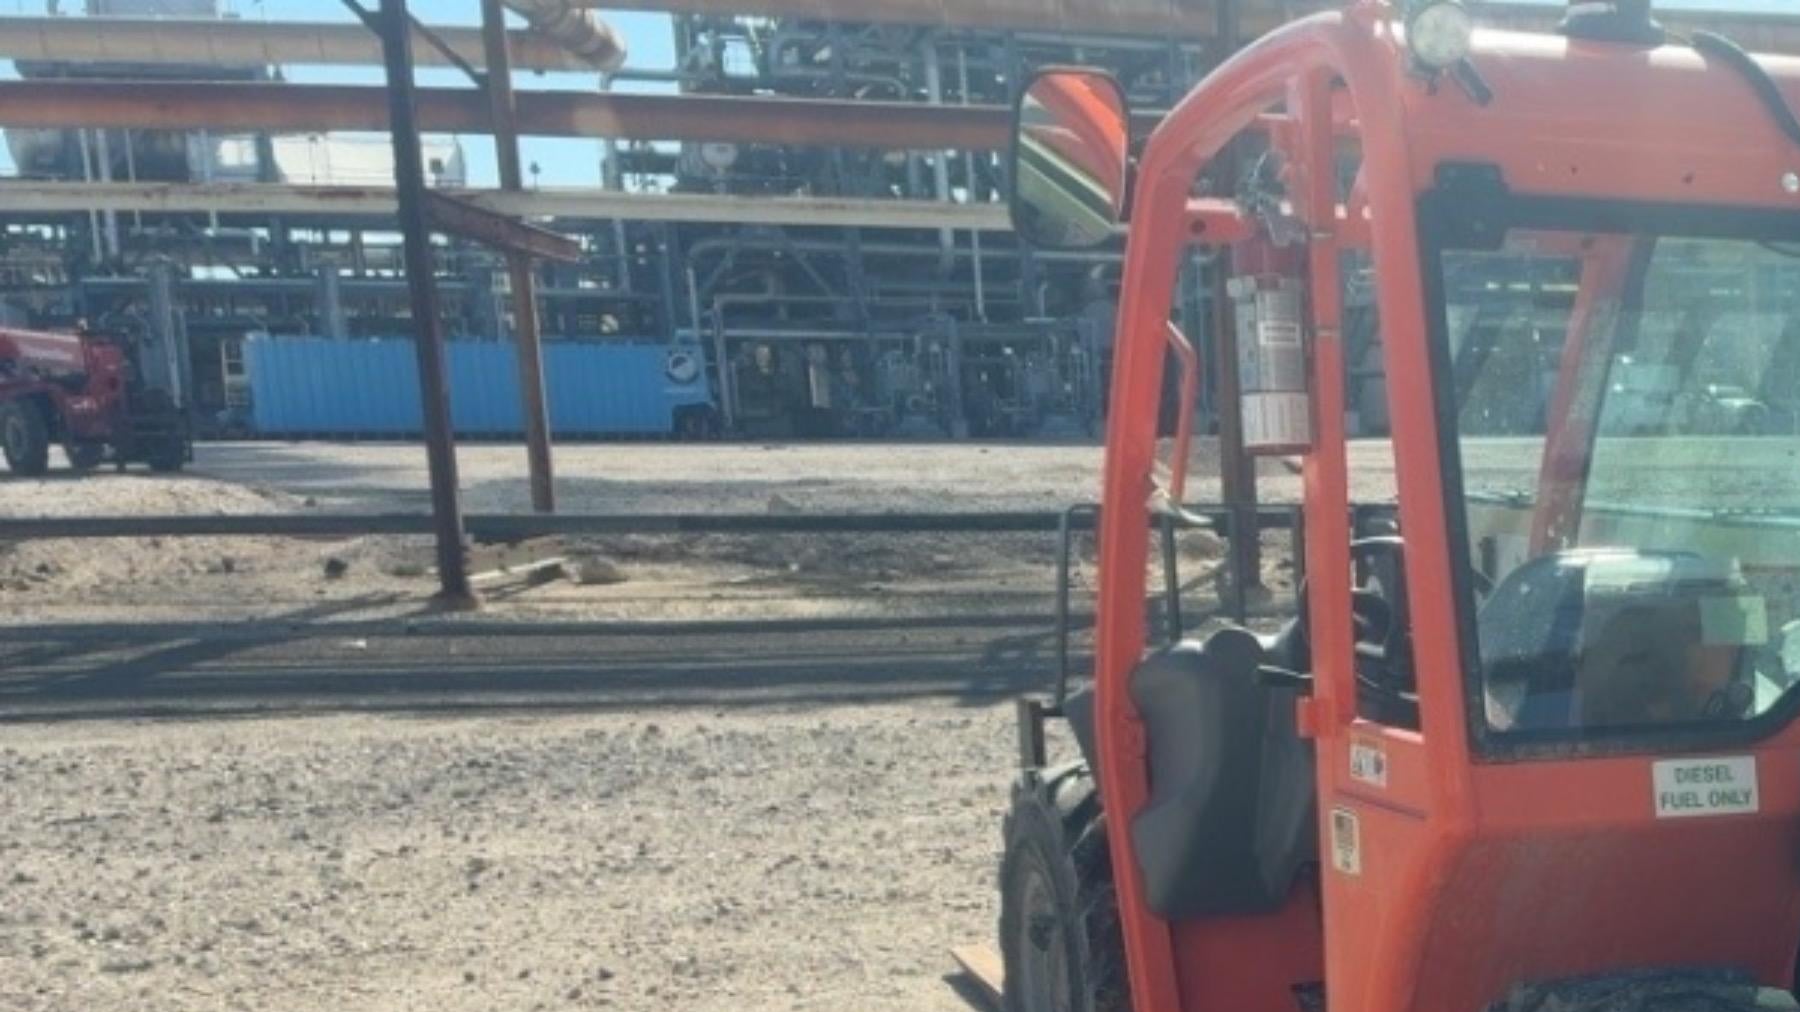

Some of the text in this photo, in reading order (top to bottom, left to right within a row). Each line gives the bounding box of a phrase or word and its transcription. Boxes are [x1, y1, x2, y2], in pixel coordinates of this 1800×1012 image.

[1674, 764, 1735, 784] DIESEL
[1661, 787, 1753, 810] FUEL ONLY
